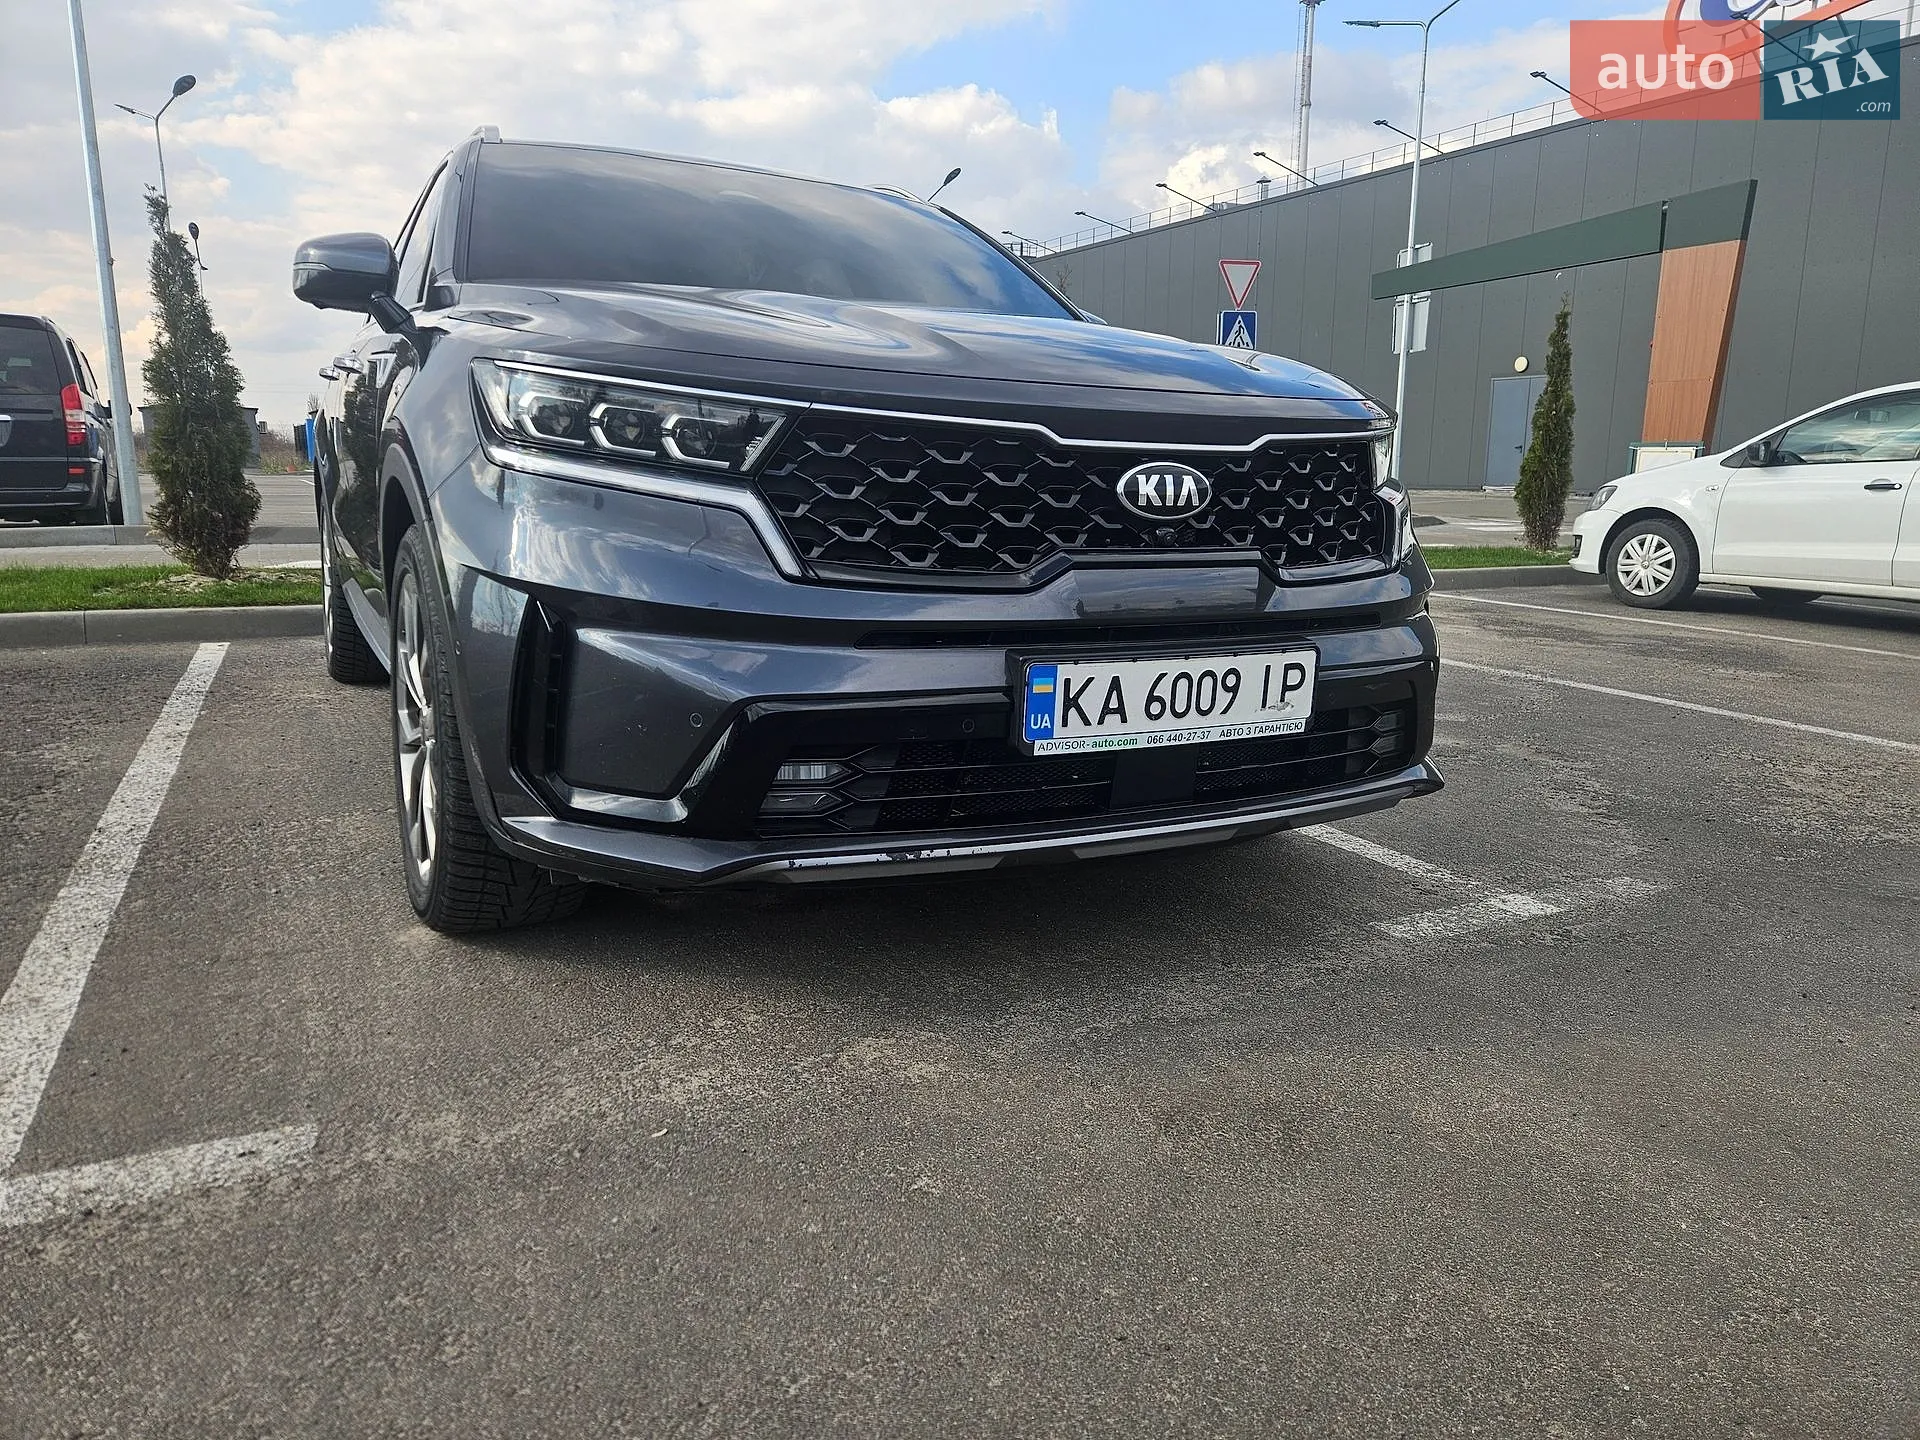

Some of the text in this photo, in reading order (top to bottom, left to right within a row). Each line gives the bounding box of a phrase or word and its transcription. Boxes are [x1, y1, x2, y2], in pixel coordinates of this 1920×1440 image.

[1136, 474, 1200, 506] KIA
[1061, 662, 1306, 727] KA 6009 IP
[1031, 713, 1051, 730] UA
[1146, 734, 1165, 745] 066
[1166, 730, 1211, 743] 440-27-37
[1219, 727, 1244, 738] АВТО
[1253, 721, 1303, 735] ГАРАНТІЄЮ
